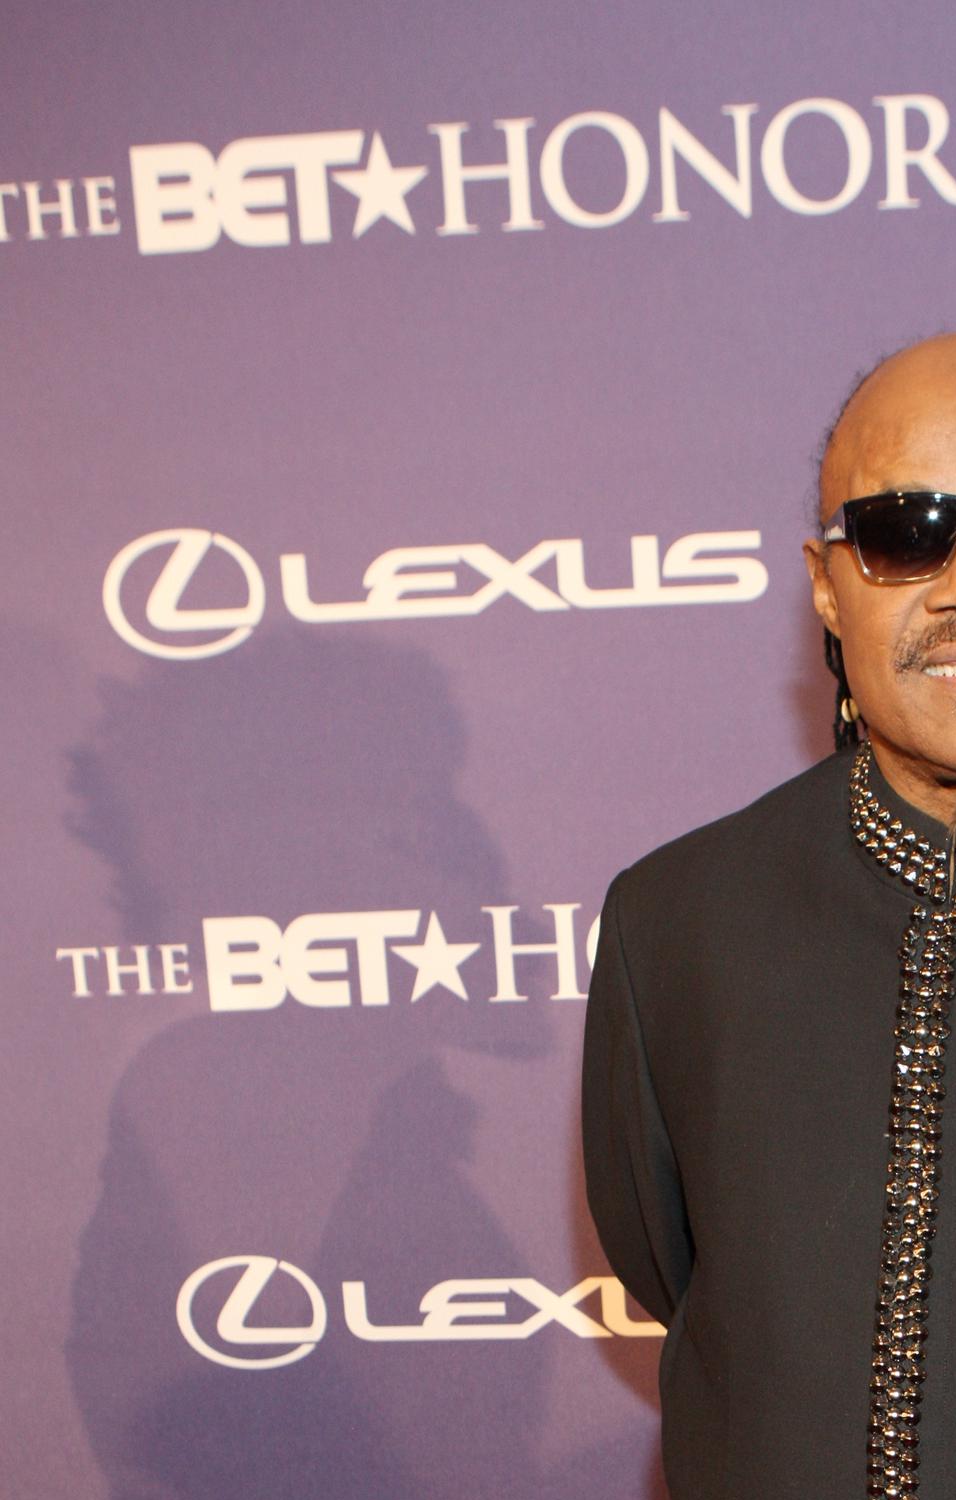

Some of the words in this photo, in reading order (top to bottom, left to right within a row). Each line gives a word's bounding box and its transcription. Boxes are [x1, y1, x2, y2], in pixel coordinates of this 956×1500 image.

[129, 130, 366, 256] BET
[280, 530, 770, 624] LEXUS
[56, 943, 194, 998] THE
[202, 908, 422, 1013] BET
